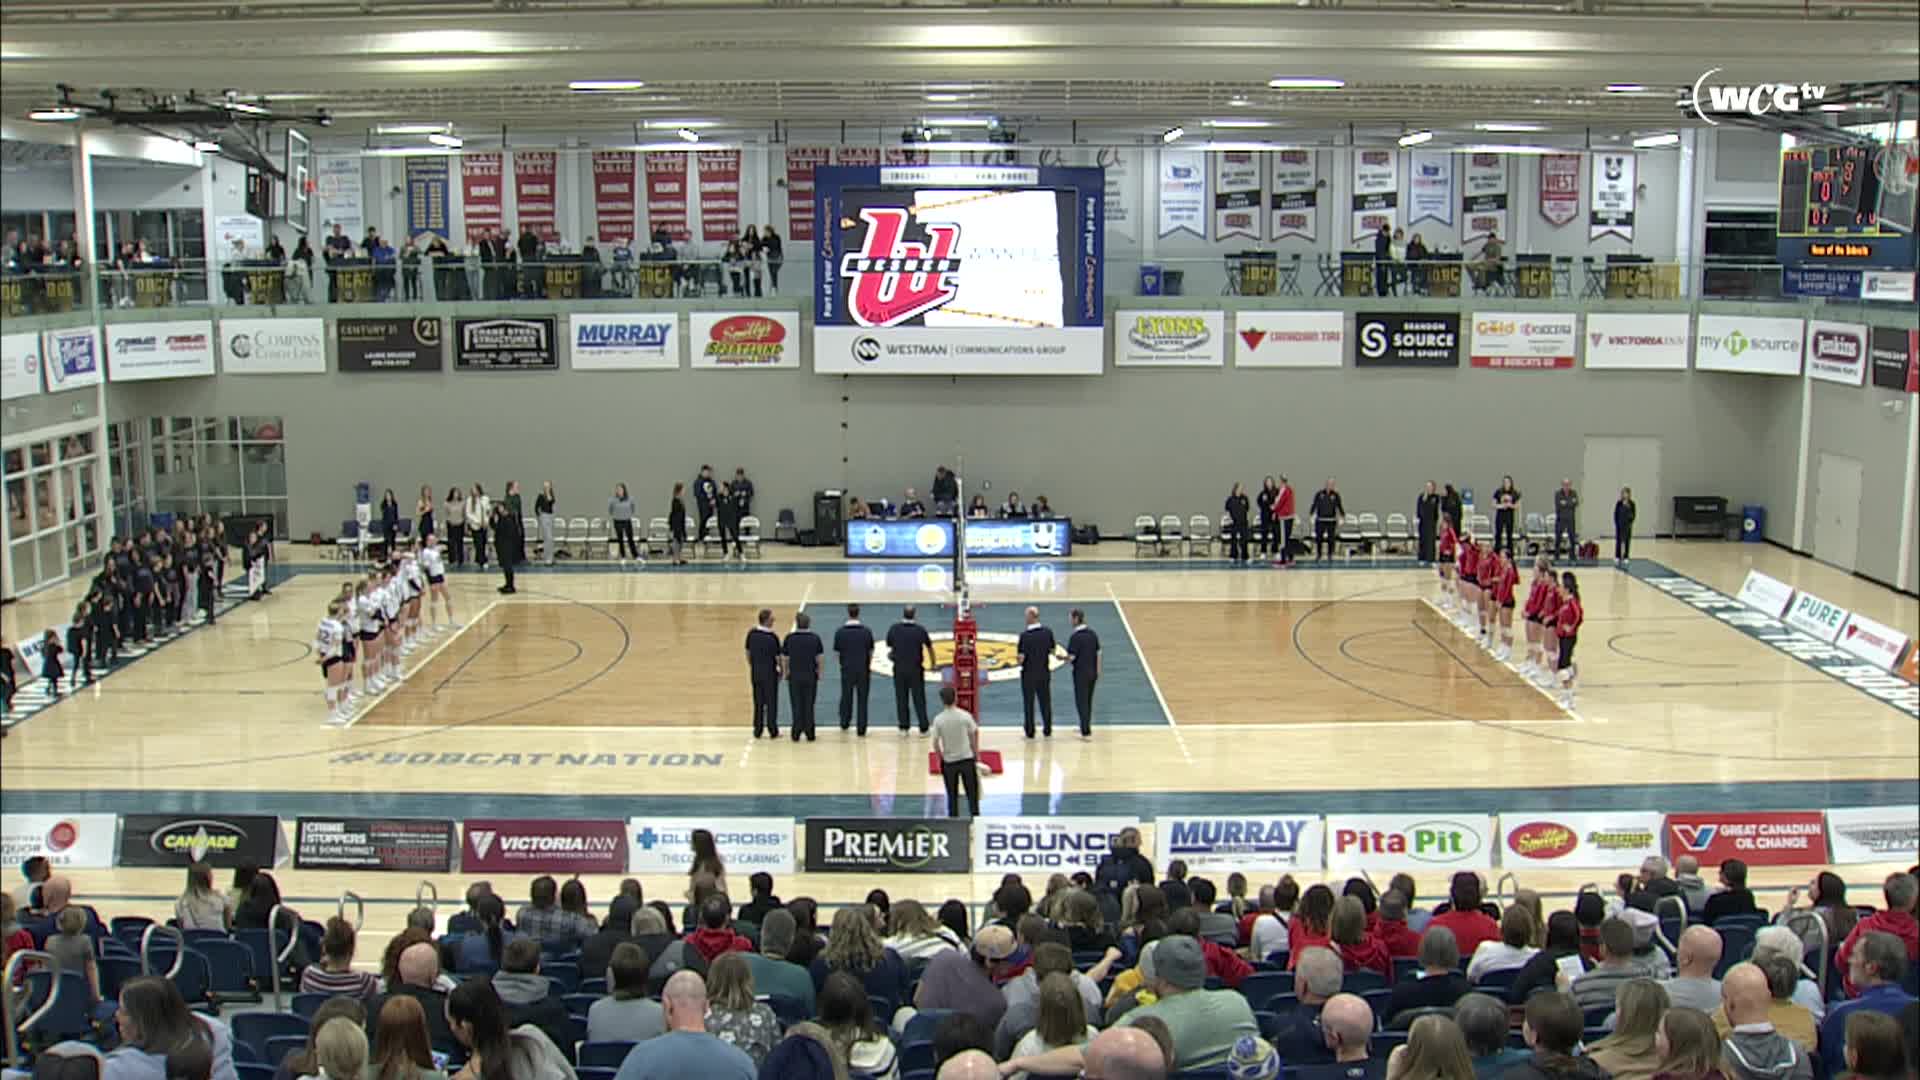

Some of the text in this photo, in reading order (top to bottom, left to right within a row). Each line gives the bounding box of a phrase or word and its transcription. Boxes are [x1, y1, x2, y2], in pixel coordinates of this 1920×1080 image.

[421, 320, 438, 337] 21
[1135, 315, 1204, 336] LYONS
[1403, 321, 1446, 331] BRANDON
[577, 324, 672, 347] MURRAY
[1393, 333, 1454, 347] SOURCE
[1700, 335, 1721, 350] my
[1750, 337, 1800, 350] source
[887, 344, 948, 355] WESTMAN
[1398, 350, 1449, 358] FOR SPORTS
[1798, 596, 1842, 627] PURE
[1171, 821, 1307, 850] MURRAY
[1720, 824, 1822, 836] GREAT CANADIAN
[307, 833, 367, 844] STOPPERS
[1336, 829, 1464, 853] Pita Pit
[1735, 837, 1808, 850] OIL CHANGE
[986, 854, 1061, 866] RADIO
